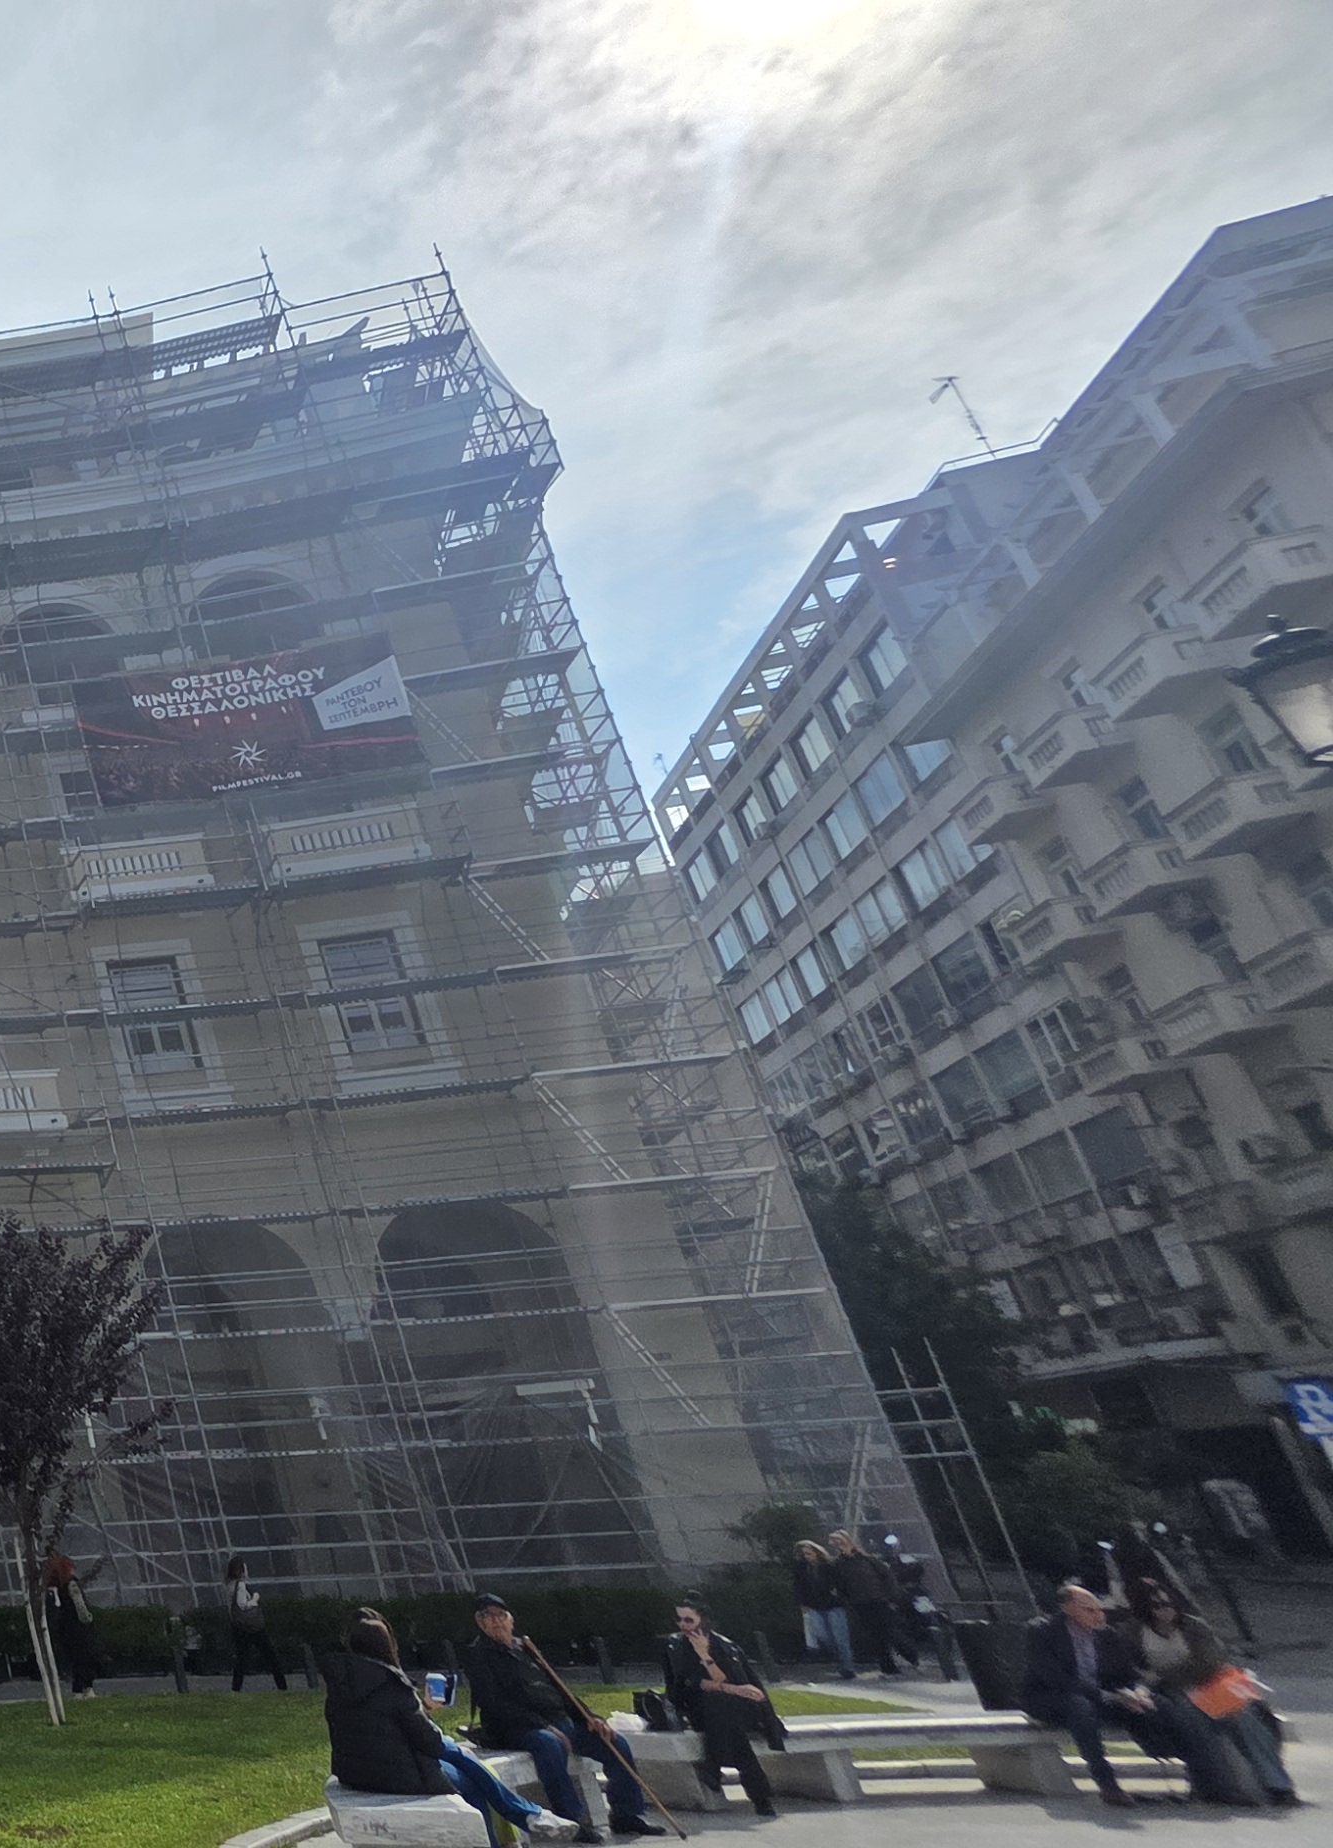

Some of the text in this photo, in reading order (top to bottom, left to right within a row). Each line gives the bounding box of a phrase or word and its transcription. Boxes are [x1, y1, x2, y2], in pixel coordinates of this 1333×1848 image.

[132, 666, 327, 709] ΚΙΝΗΜΑΤΟΓΡΑΦΟΥ
[171, 664, 278, 690] ΦΕΣΤΙΒΑΛ
[151, 683, 316, 720] ΘΕΣΣΑΛΟΝΙΚΗΣ
[325, 676, 384, 707] ΡΑΝΤΕΒΟΥ
[340, 695, 367, 710] ΤΟΝ
[328, 697, 399, 724] ΣΕΠΤΕΜΒΡΗ
[212, 771, 303, 793] FILMFESTIVAL.GR
